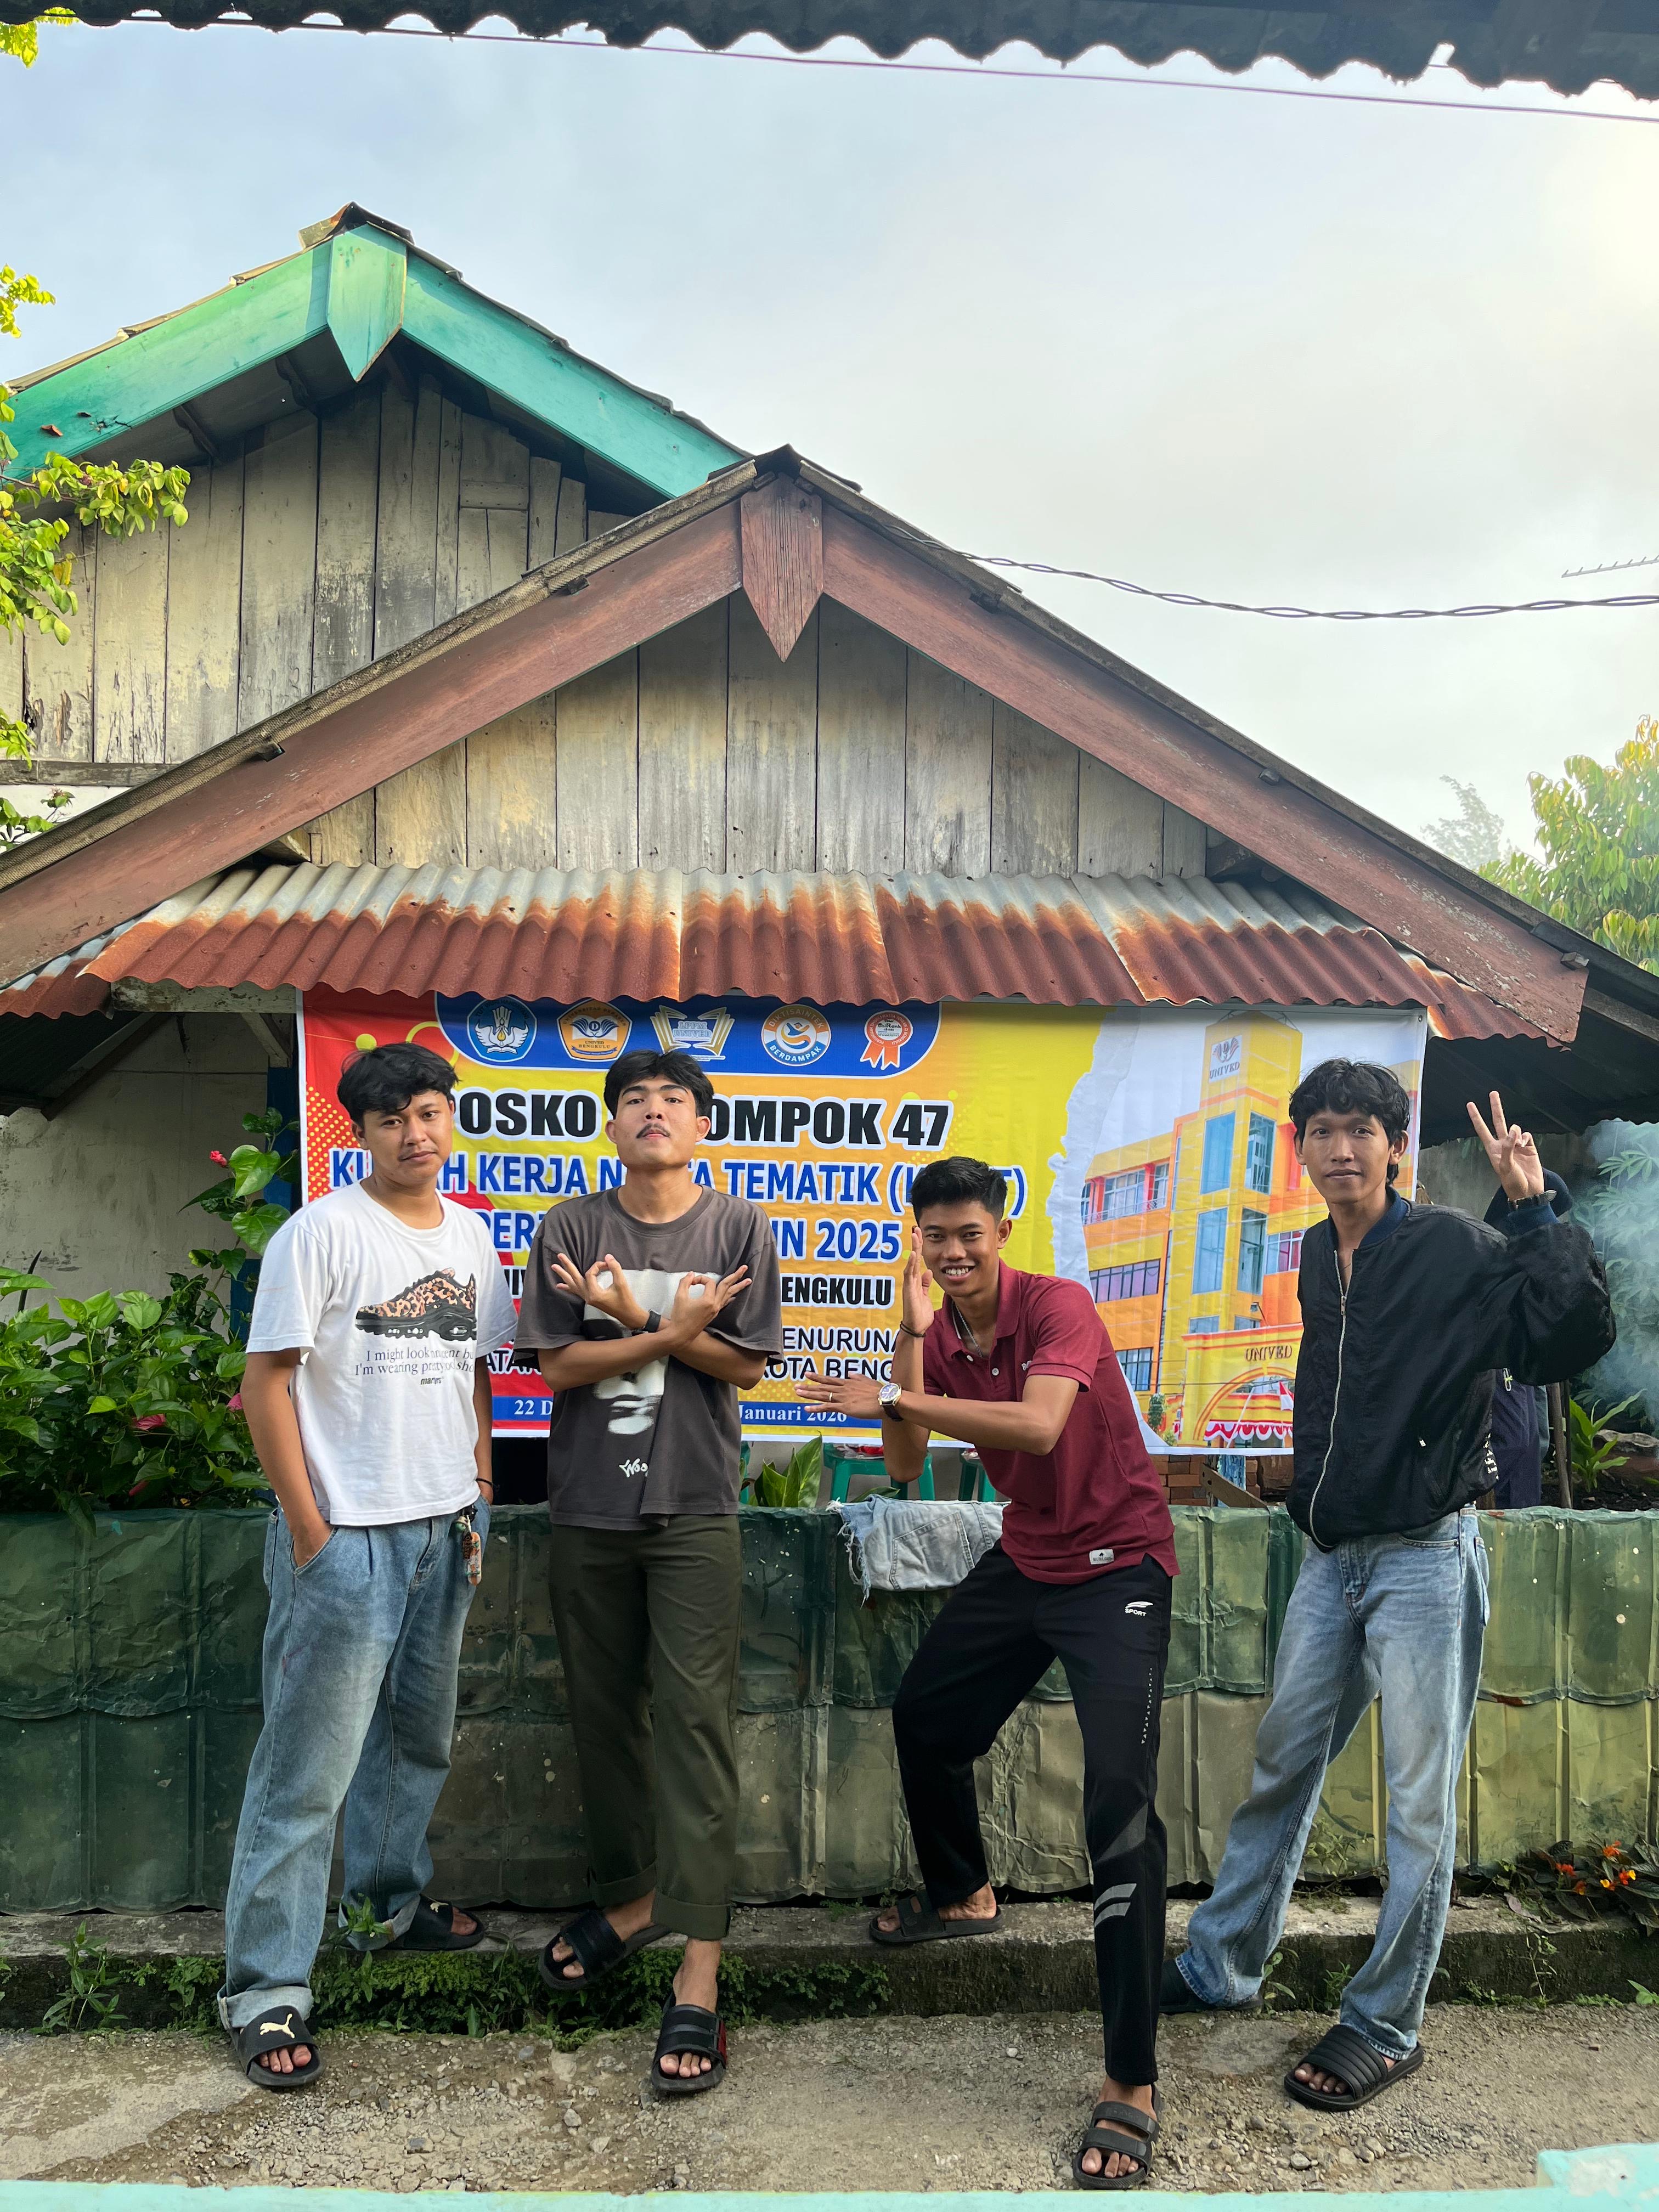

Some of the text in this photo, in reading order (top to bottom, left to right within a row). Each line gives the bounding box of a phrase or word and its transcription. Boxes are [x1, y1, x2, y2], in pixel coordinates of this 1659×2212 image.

[679, 1022, 707, 1030] LPPM
[769, 1009, 825, 1029] DIKTISAINTEK
[673, 1029, 712, 1037] UNIVED
[769, 1045, 822, 1062] BERDAMPAK
[1209, 1062, 1240, 1079] UNIVED
[459, 1092, 948, 1146] OSKO OMPOK 47
[479, 1155, 587, 1195] KERJA
[724, 1163, 878, 1203] TEMATIK
[816, 1221, 900, 1260] 2025
[781, 1277, 892, 1306] ENGKULU
[366, 1350, 370, 1361] I
[375, 1350, 404, 1363] might
[407, 1347, 430, 1358] look
[1245, 1345, 1293, 1361] UNIVED
[355, 1363, 374, 1376] I'm
[377, 1361, 419, 1375] wearing
[764, 1357, 815, 1380] OTA
[514, 1400, 535, 1415] 22
[738, 1404, 802, 1421] Januari
[1125, 1608, 1147, 1617] SPORT
